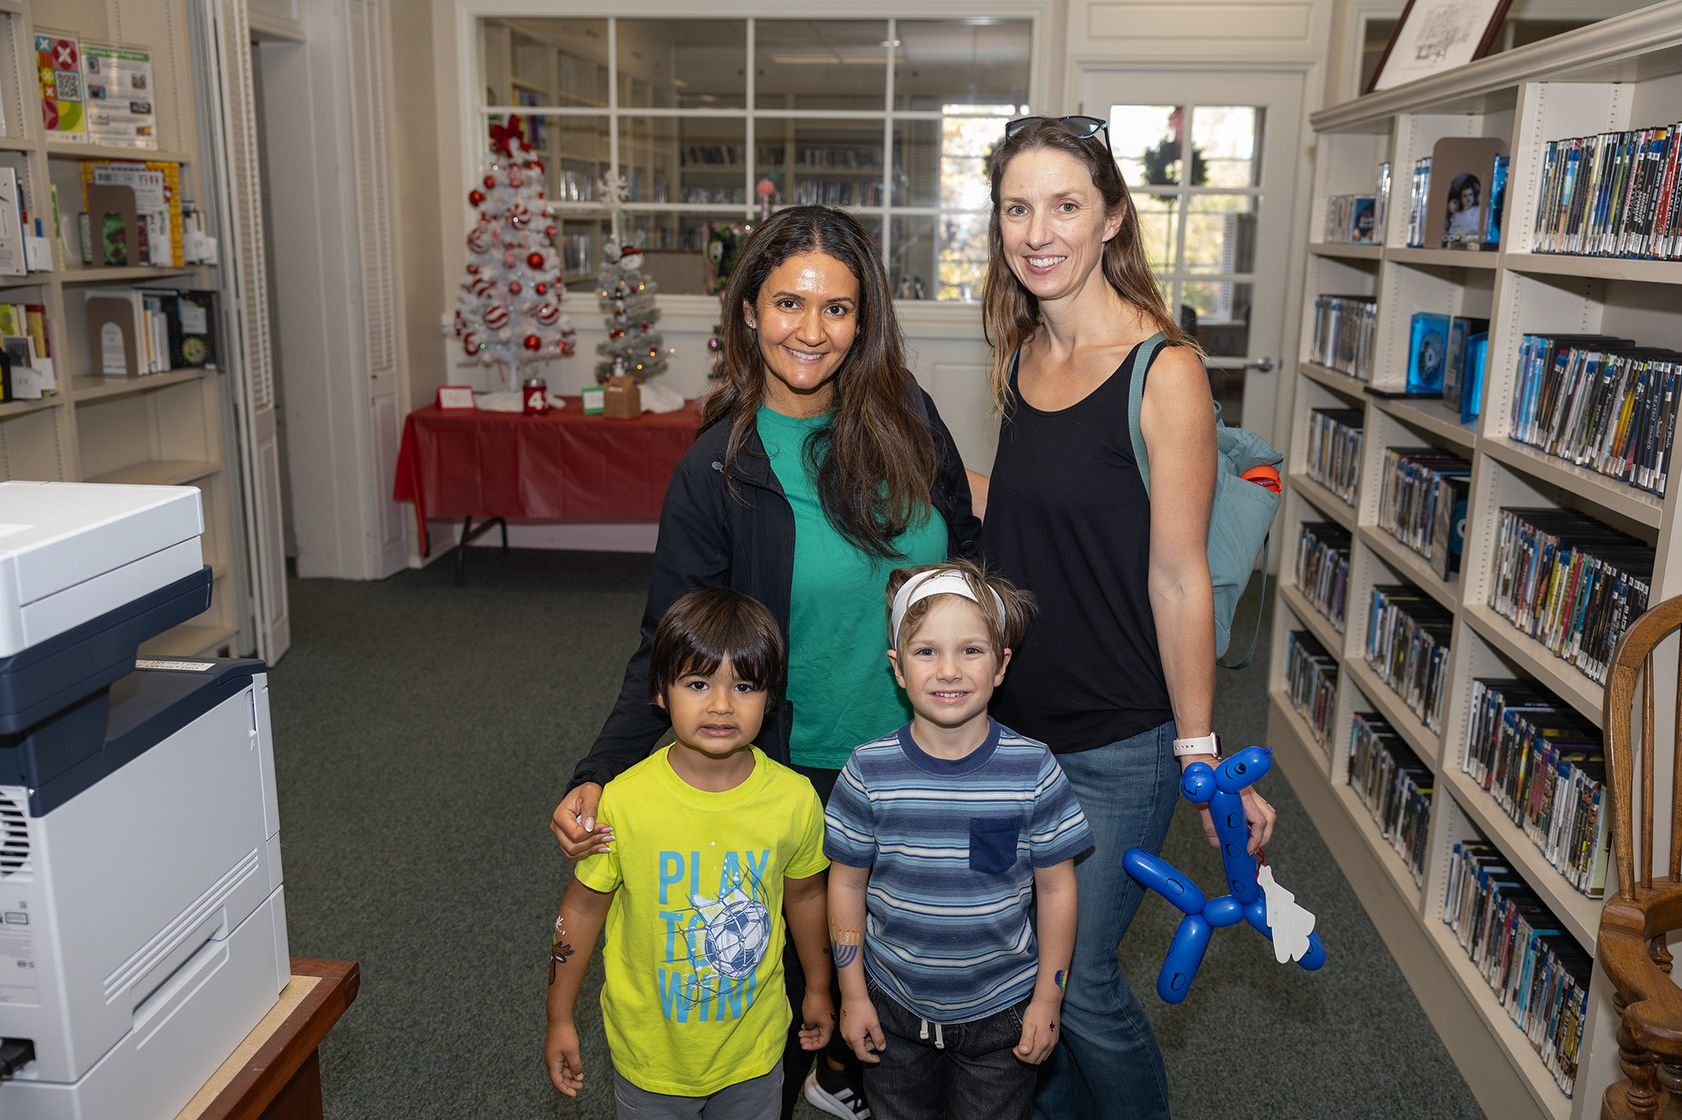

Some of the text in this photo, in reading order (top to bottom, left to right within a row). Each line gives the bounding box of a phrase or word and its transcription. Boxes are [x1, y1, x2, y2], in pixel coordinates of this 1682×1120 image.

[1625, 184, 1634, 207] DRIVER
[1620, 605, 1630, 631] BLACK
[659, 849, 771, 906] PLAY
[659, 911, 711, 967] TO
